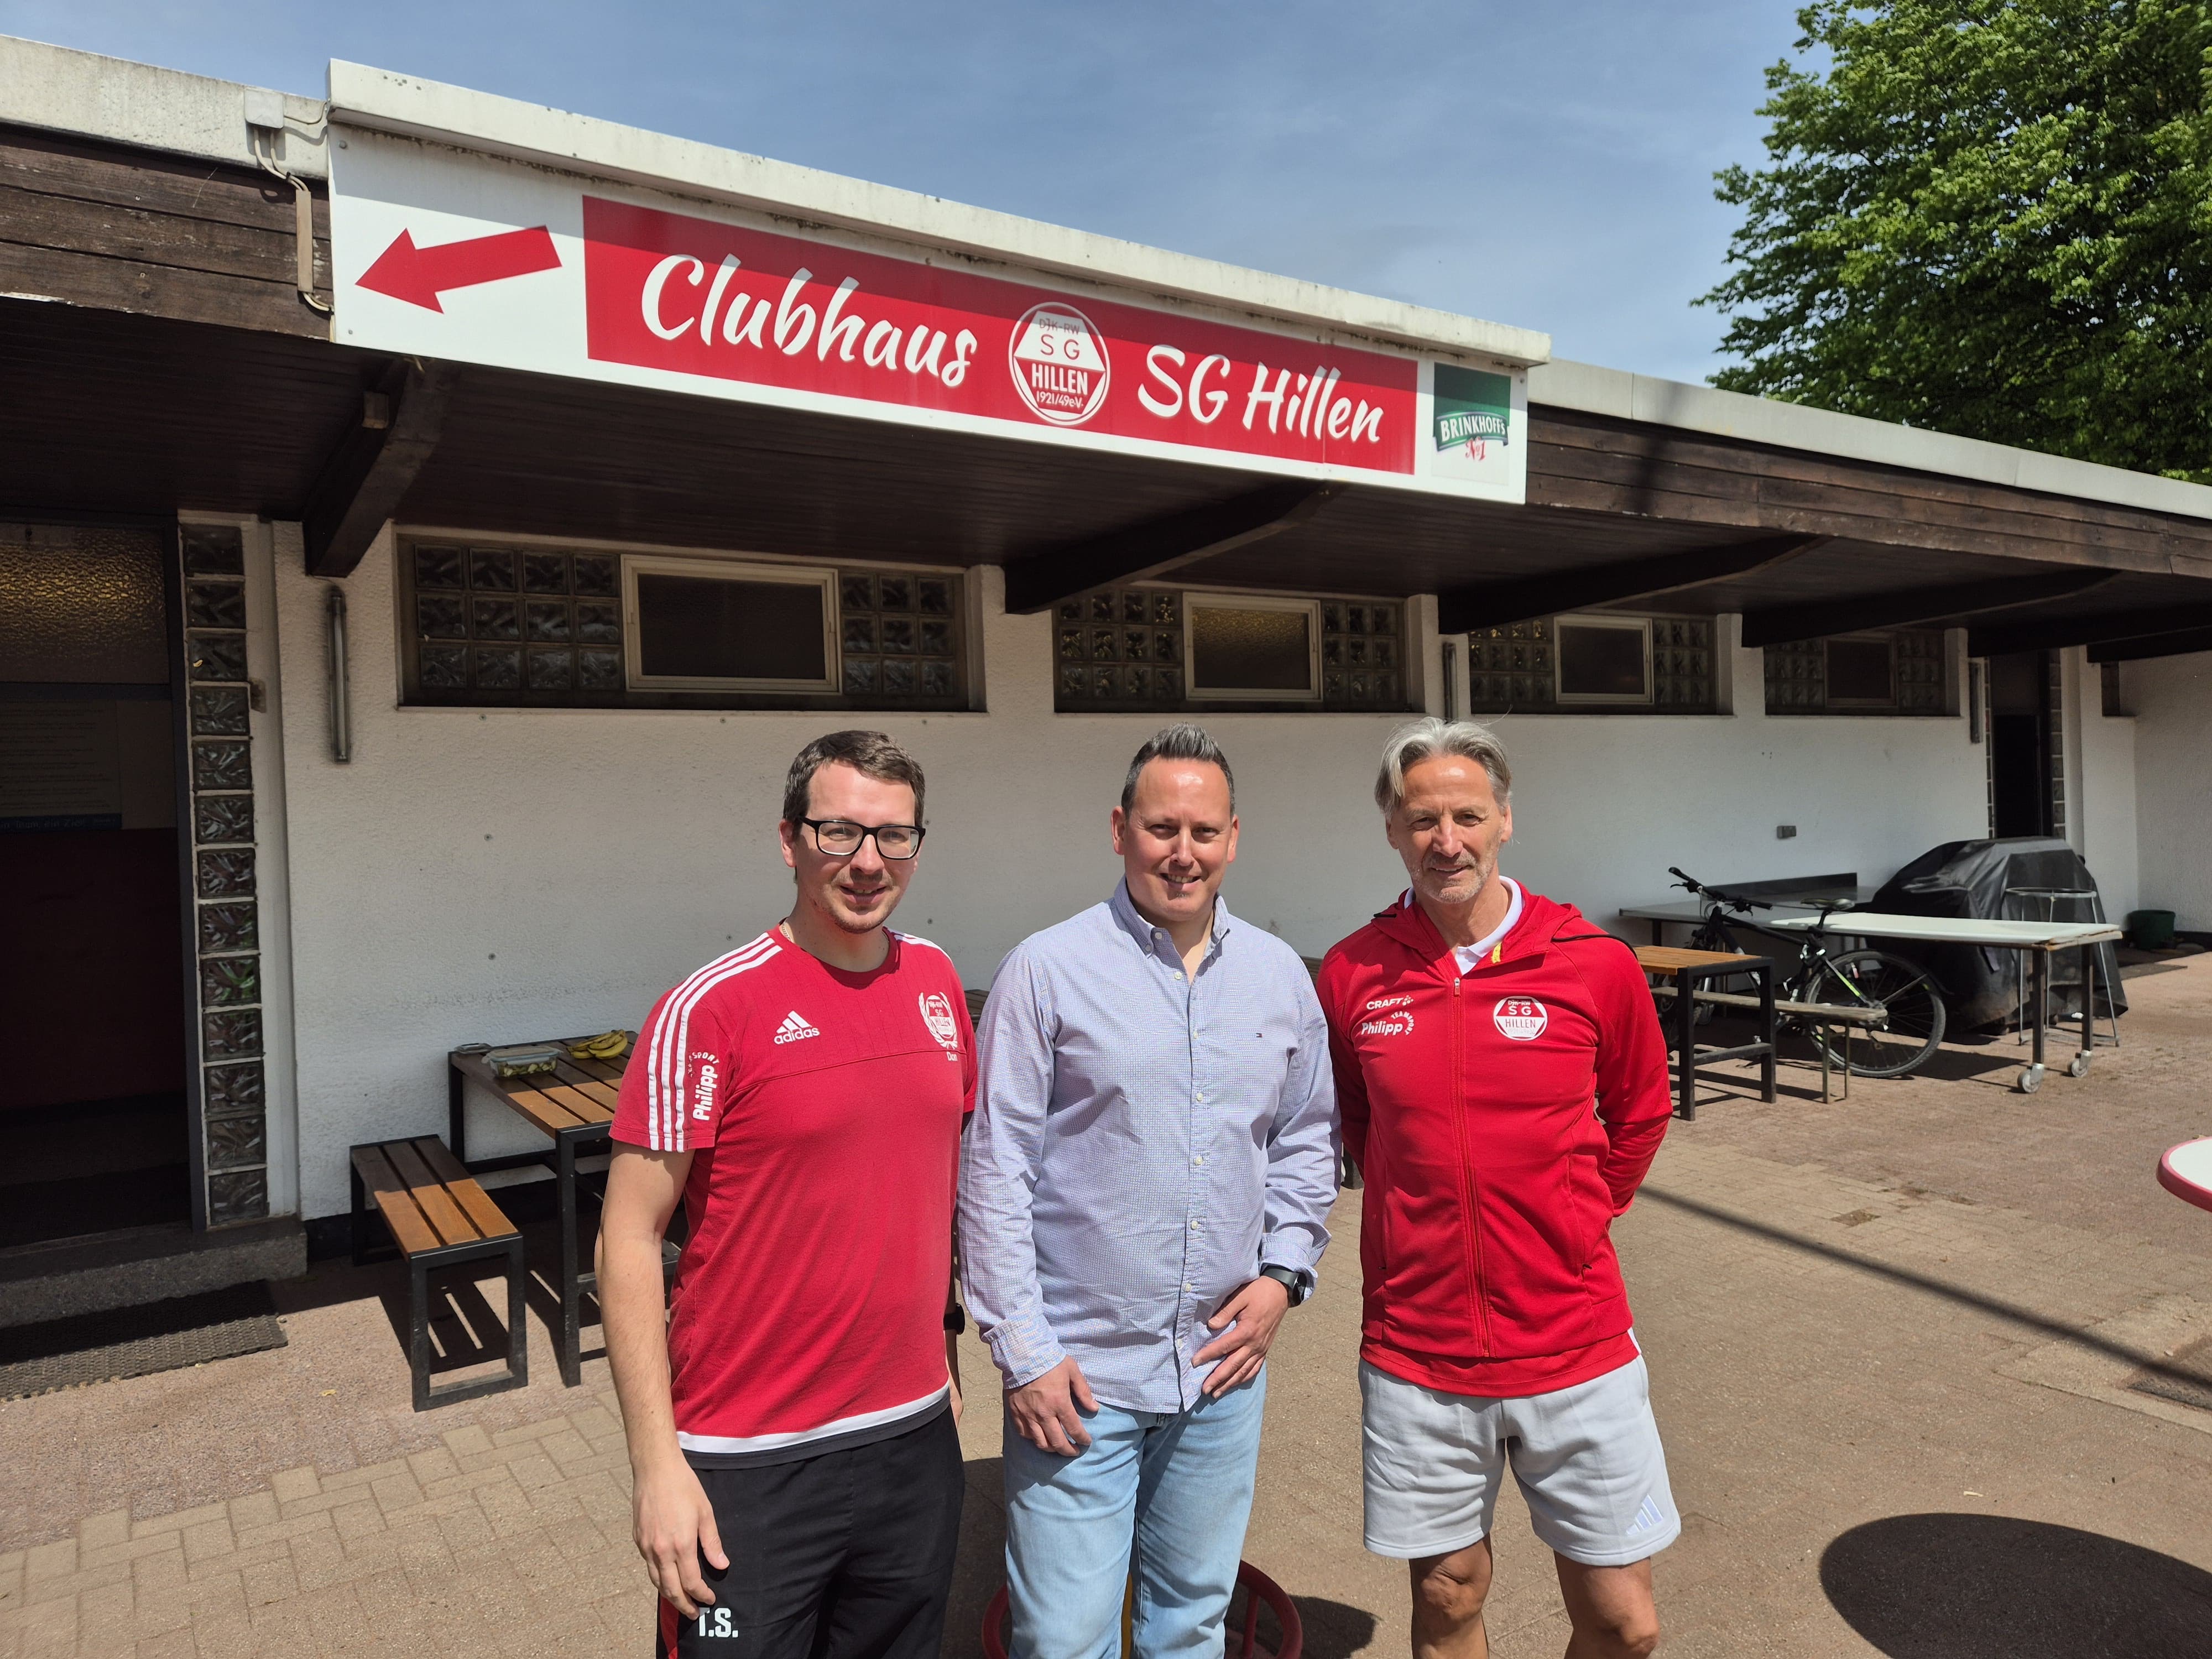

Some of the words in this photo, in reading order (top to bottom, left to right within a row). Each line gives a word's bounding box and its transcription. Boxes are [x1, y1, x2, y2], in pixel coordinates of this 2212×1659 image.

[641, 253, 977, 387] Clubhaus
[1039, 319, 1079, 335] DJK-RW
[1031, 363, 1088, 395] HILLEN
[1138, 344, 1231, 424] SG
[1241, 361, 1384, 442] Hillen
[1366, 998, 1404, 1010] CRAFT
[1361, 1021, 1403, 1036] Philipp
[1505, 1019, 1536, 1028] HILLEN
[774, 1027, 820, 1045] adidas
[693, 1065, 718, 1120] Philipp
[699, 1607, 738, 1638] T.S.
